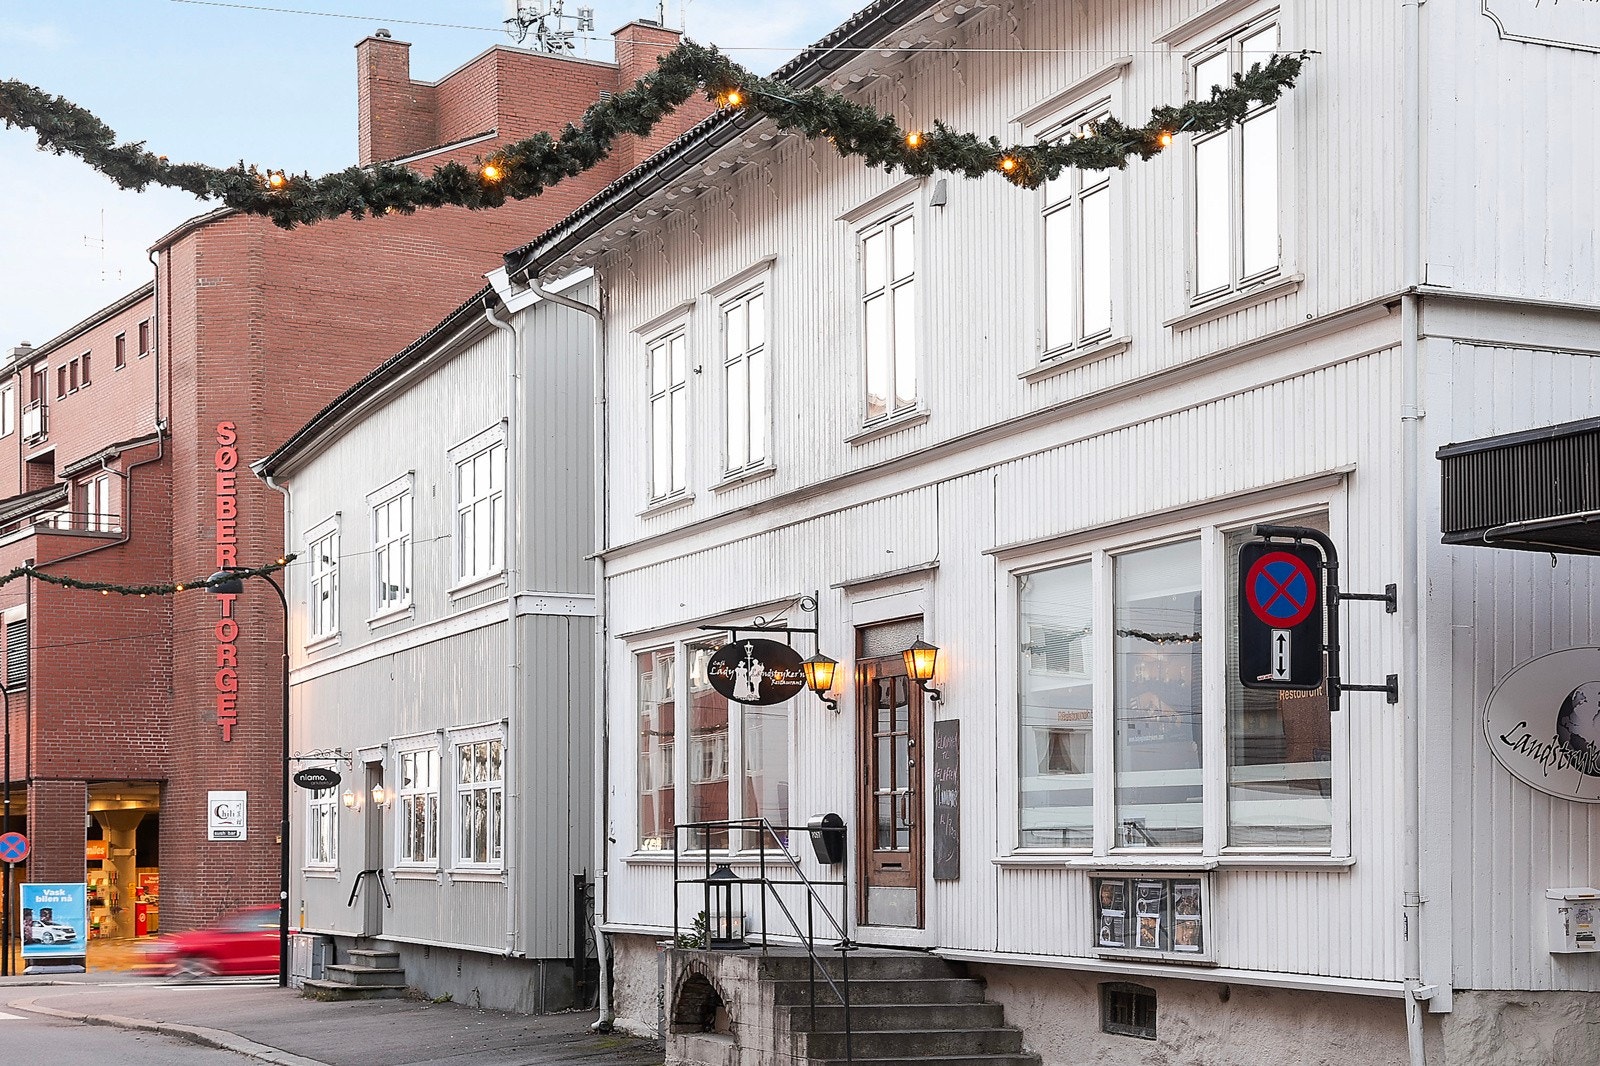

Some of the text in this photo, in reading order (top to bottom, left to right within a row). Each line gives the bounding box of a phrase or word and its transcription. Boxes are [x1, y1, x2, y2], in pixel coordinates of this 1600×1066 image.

[215, 421, 239, 741] SØEBERTORGET
[709, 666, 735, 680] Lady
[214, 803, 235, 820] Chili
[35, 894, 73, 903] bilen nå
[42, 888, 66, 896] Vask
